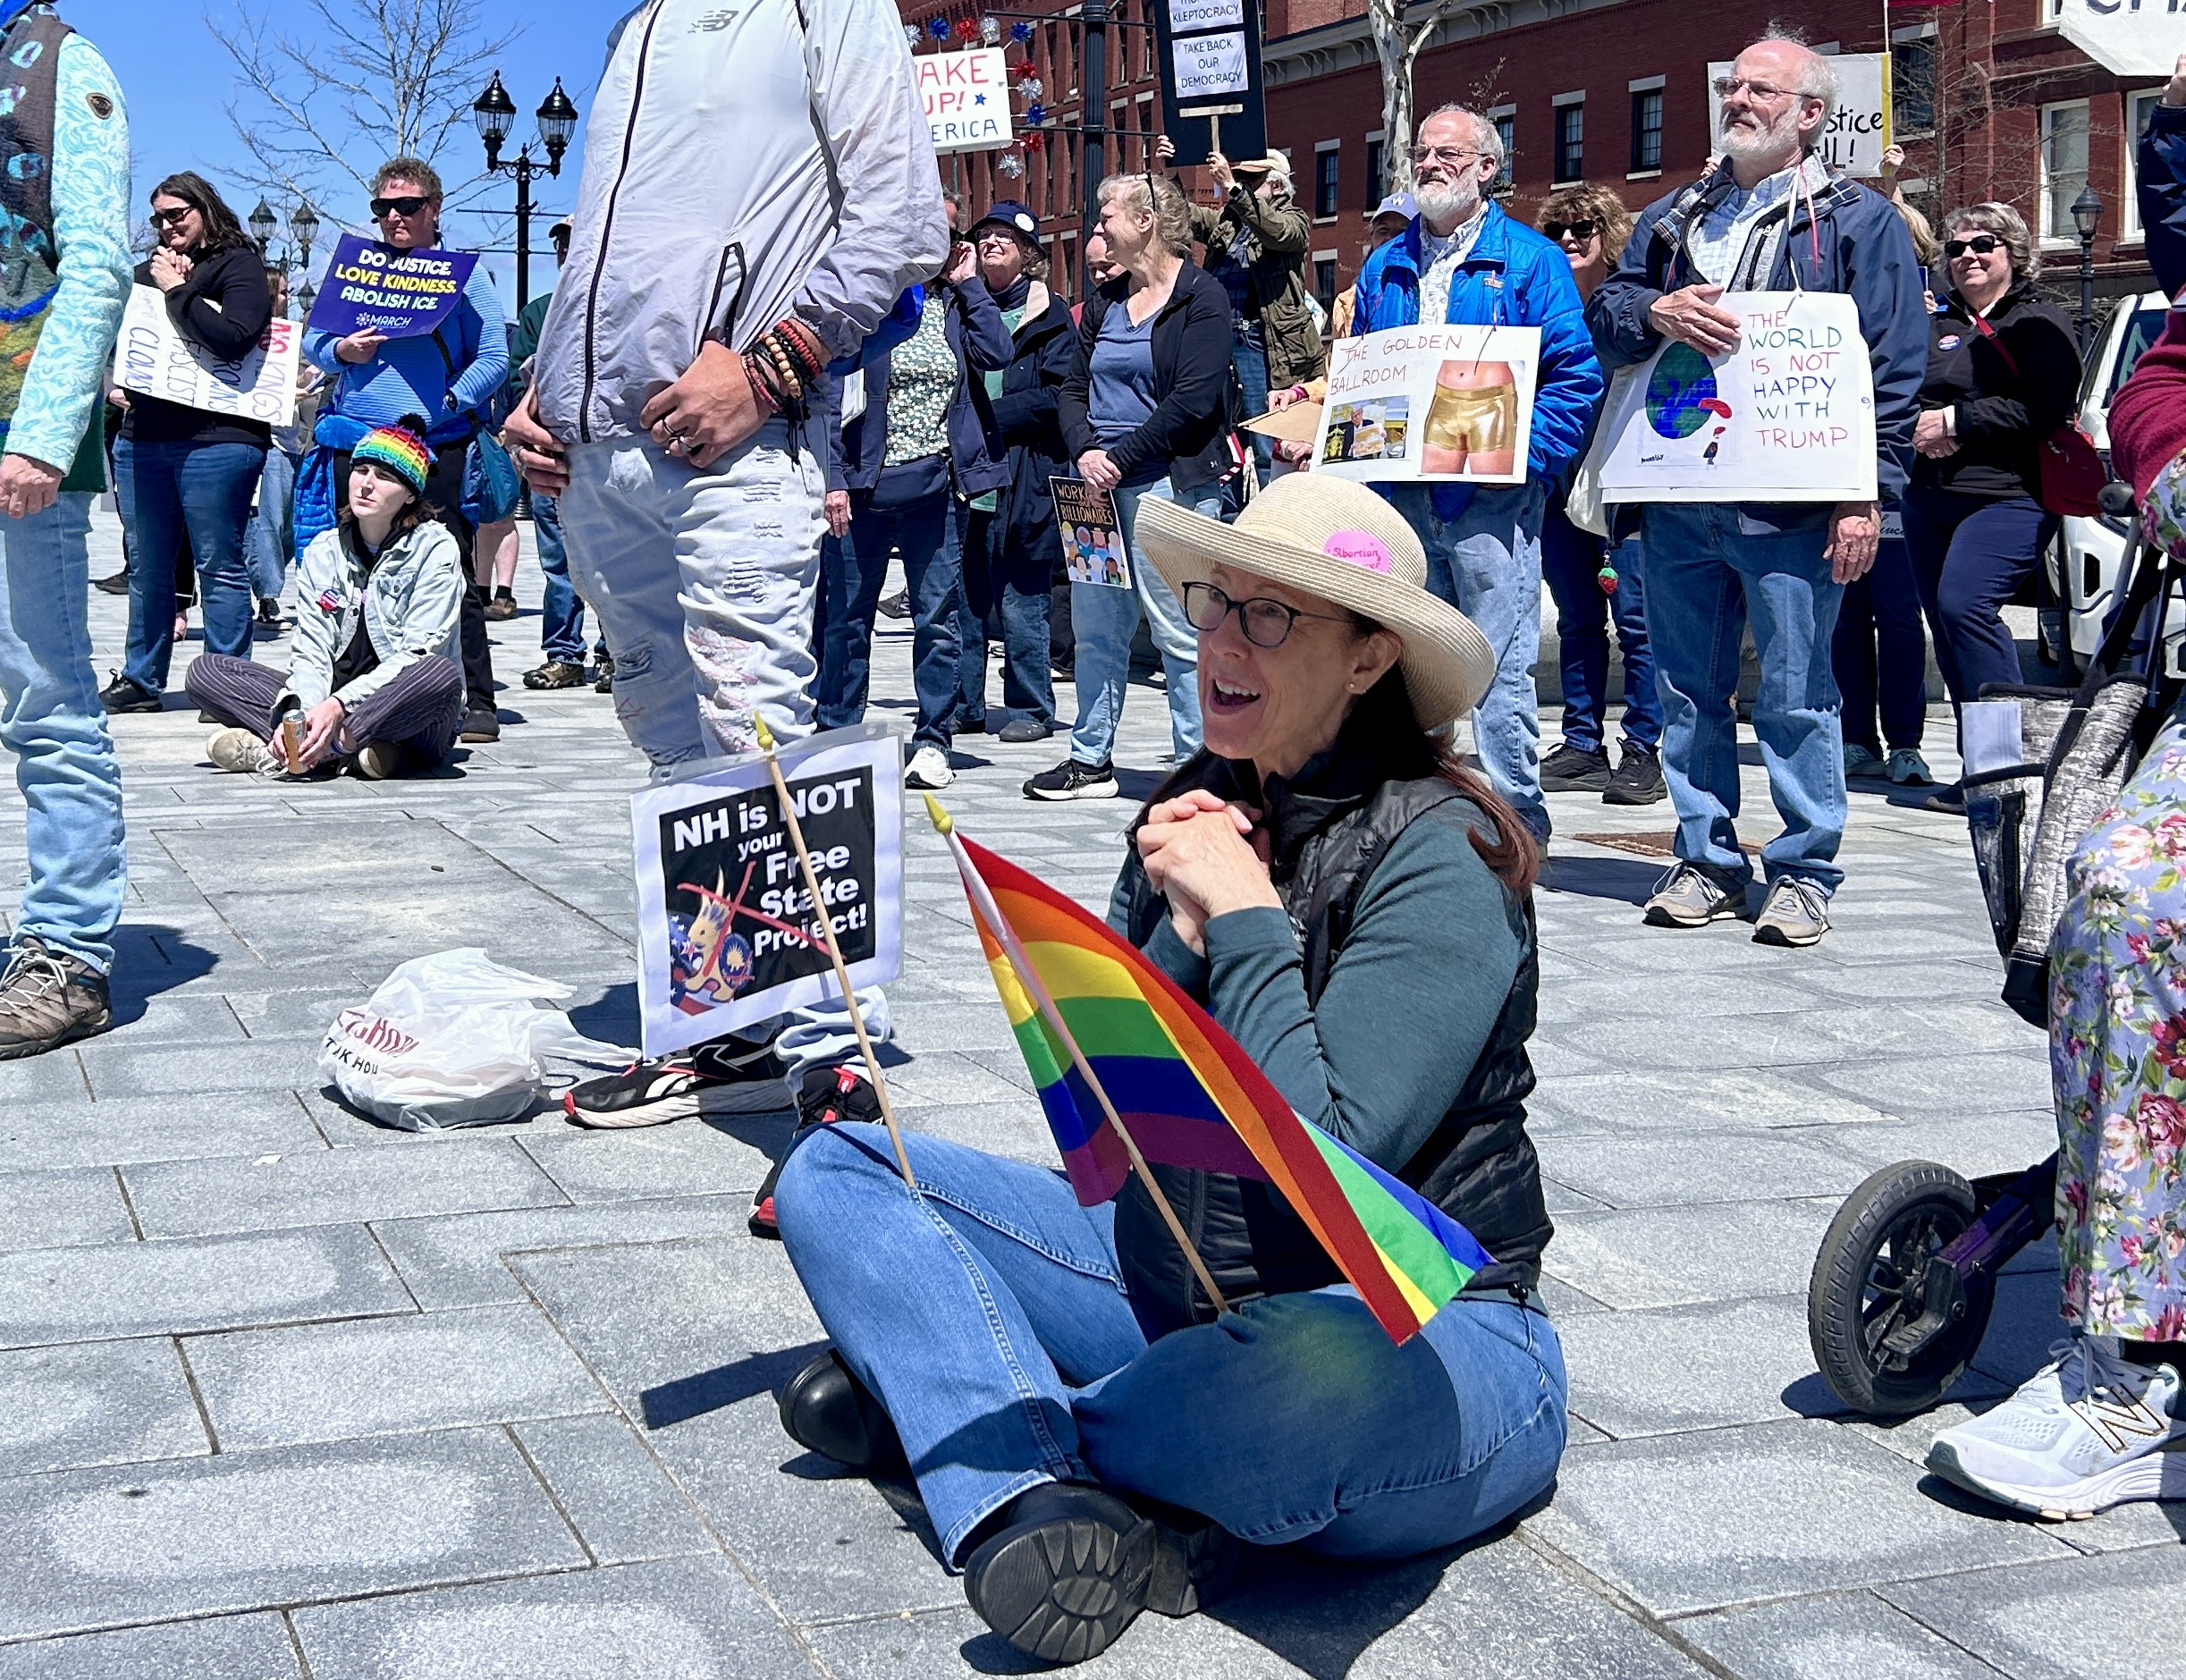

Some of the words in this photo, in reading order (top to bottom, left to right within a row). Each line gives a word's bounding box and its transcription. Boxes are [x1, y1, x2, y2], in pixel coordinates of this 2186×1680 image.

[1172, 4, 1239, 23] KLEPTOCRACY
[1183, 42, 1205, 55] TAKE
[1206, 38, 1234, 52] BACK
[915, 55, 990, 88] AKE
[1198, 56, 1220, 70] OUR
[1181, 71, 1242, 89] DEMOCRACY
[931, 118, 999, 142] ERICA
[1825, 104, 1885, 134] stice
[358, 249, 387, 267] DO
[334, 263, 382, 287] LOVE
[382, 274, 457, 294] KINDNESS.
[340, 285, 411, 309] ABOLISH
[368, 314, 413, 327] MARCH
[1747, 310, 1788, 329] THE
[1346, 344, 1369, 362] THE
[1382, 334, 1463, 356] GOLDEN
[1748, 325, 1843, 350] WORLD
[124, 326, 160, 393] CLOWNS
[1751, 358, 1770, 375] IS
[1789, 351, 1841, 372] NOT
[207, 357, 243, 413] ROWNS
[252, 359, 287, 423] KINGS
[1329, 364, 1407, 395] BALLROOM
[1753, 376, 1836, 399] HAPPY
[1756, 401, 1830, 420] WITH
[1755, 426, 1849, 449] TRUMP
[1056, 483, 1086, 501] WORK
[1059, 503, 1114, 526] BILLIONAIRES
[673, 808, 730, 852] NH
[738, 803, 768, 834] is
[779, 777, 862, 823] NOT
[737, 831, 785, 863] your
[765, 845, 850, 885] Free
[760, 877, 859, 919] State
[753, 903, 867, 957] Project!
